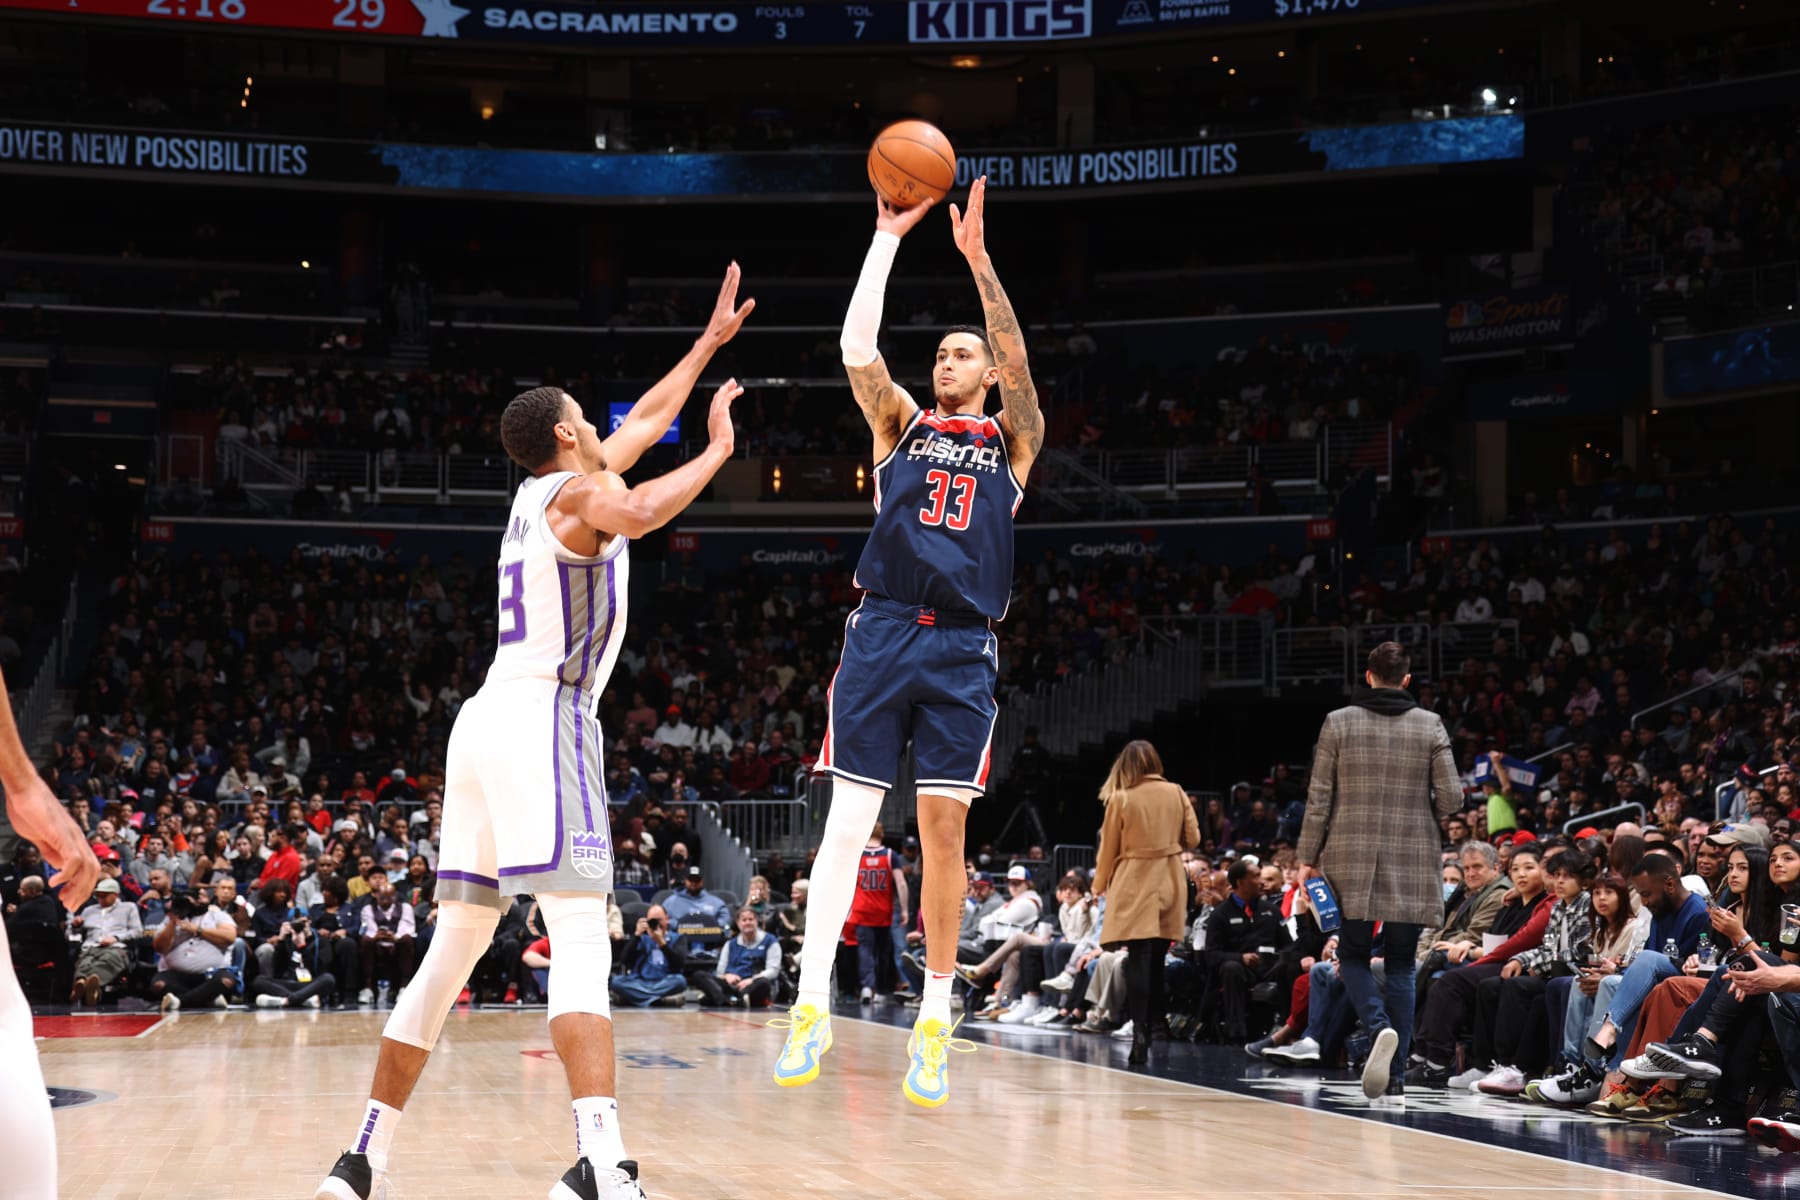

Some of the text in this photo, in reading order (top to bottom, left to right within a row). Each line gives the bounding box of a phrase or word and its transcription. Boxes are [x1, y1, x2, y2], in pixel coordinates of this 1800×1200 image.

[332, 0, 386, 29] 29
[483, 8, 738, 33] SACRAMENTO
[755, 6, 805, 18] FOULS
[845, 5, 872, 17] TOL
[915, 0, 1085, 39] KINGS
[1194, 5, 1230, 17] RAFFLE
[775, 21, 787, 40] 3
[854, 20, 866, 39] 7
[0, 127, 308, 175] OVER NEW POSSIBILITIES
[957, 142, 1238, 187] OVER NEW POSSIBILITIES
[1485, 294, 1568, 326] Sports
[1449, 319, 1562, 345] WASHINGTON
[908, 432, 1001, 468] district
[919, 468, 977, 531] 33
[573, 848, 608, 861] SAC
[860, 868, 887, 891] 202
[1315, 888, 1328, 902] 3
